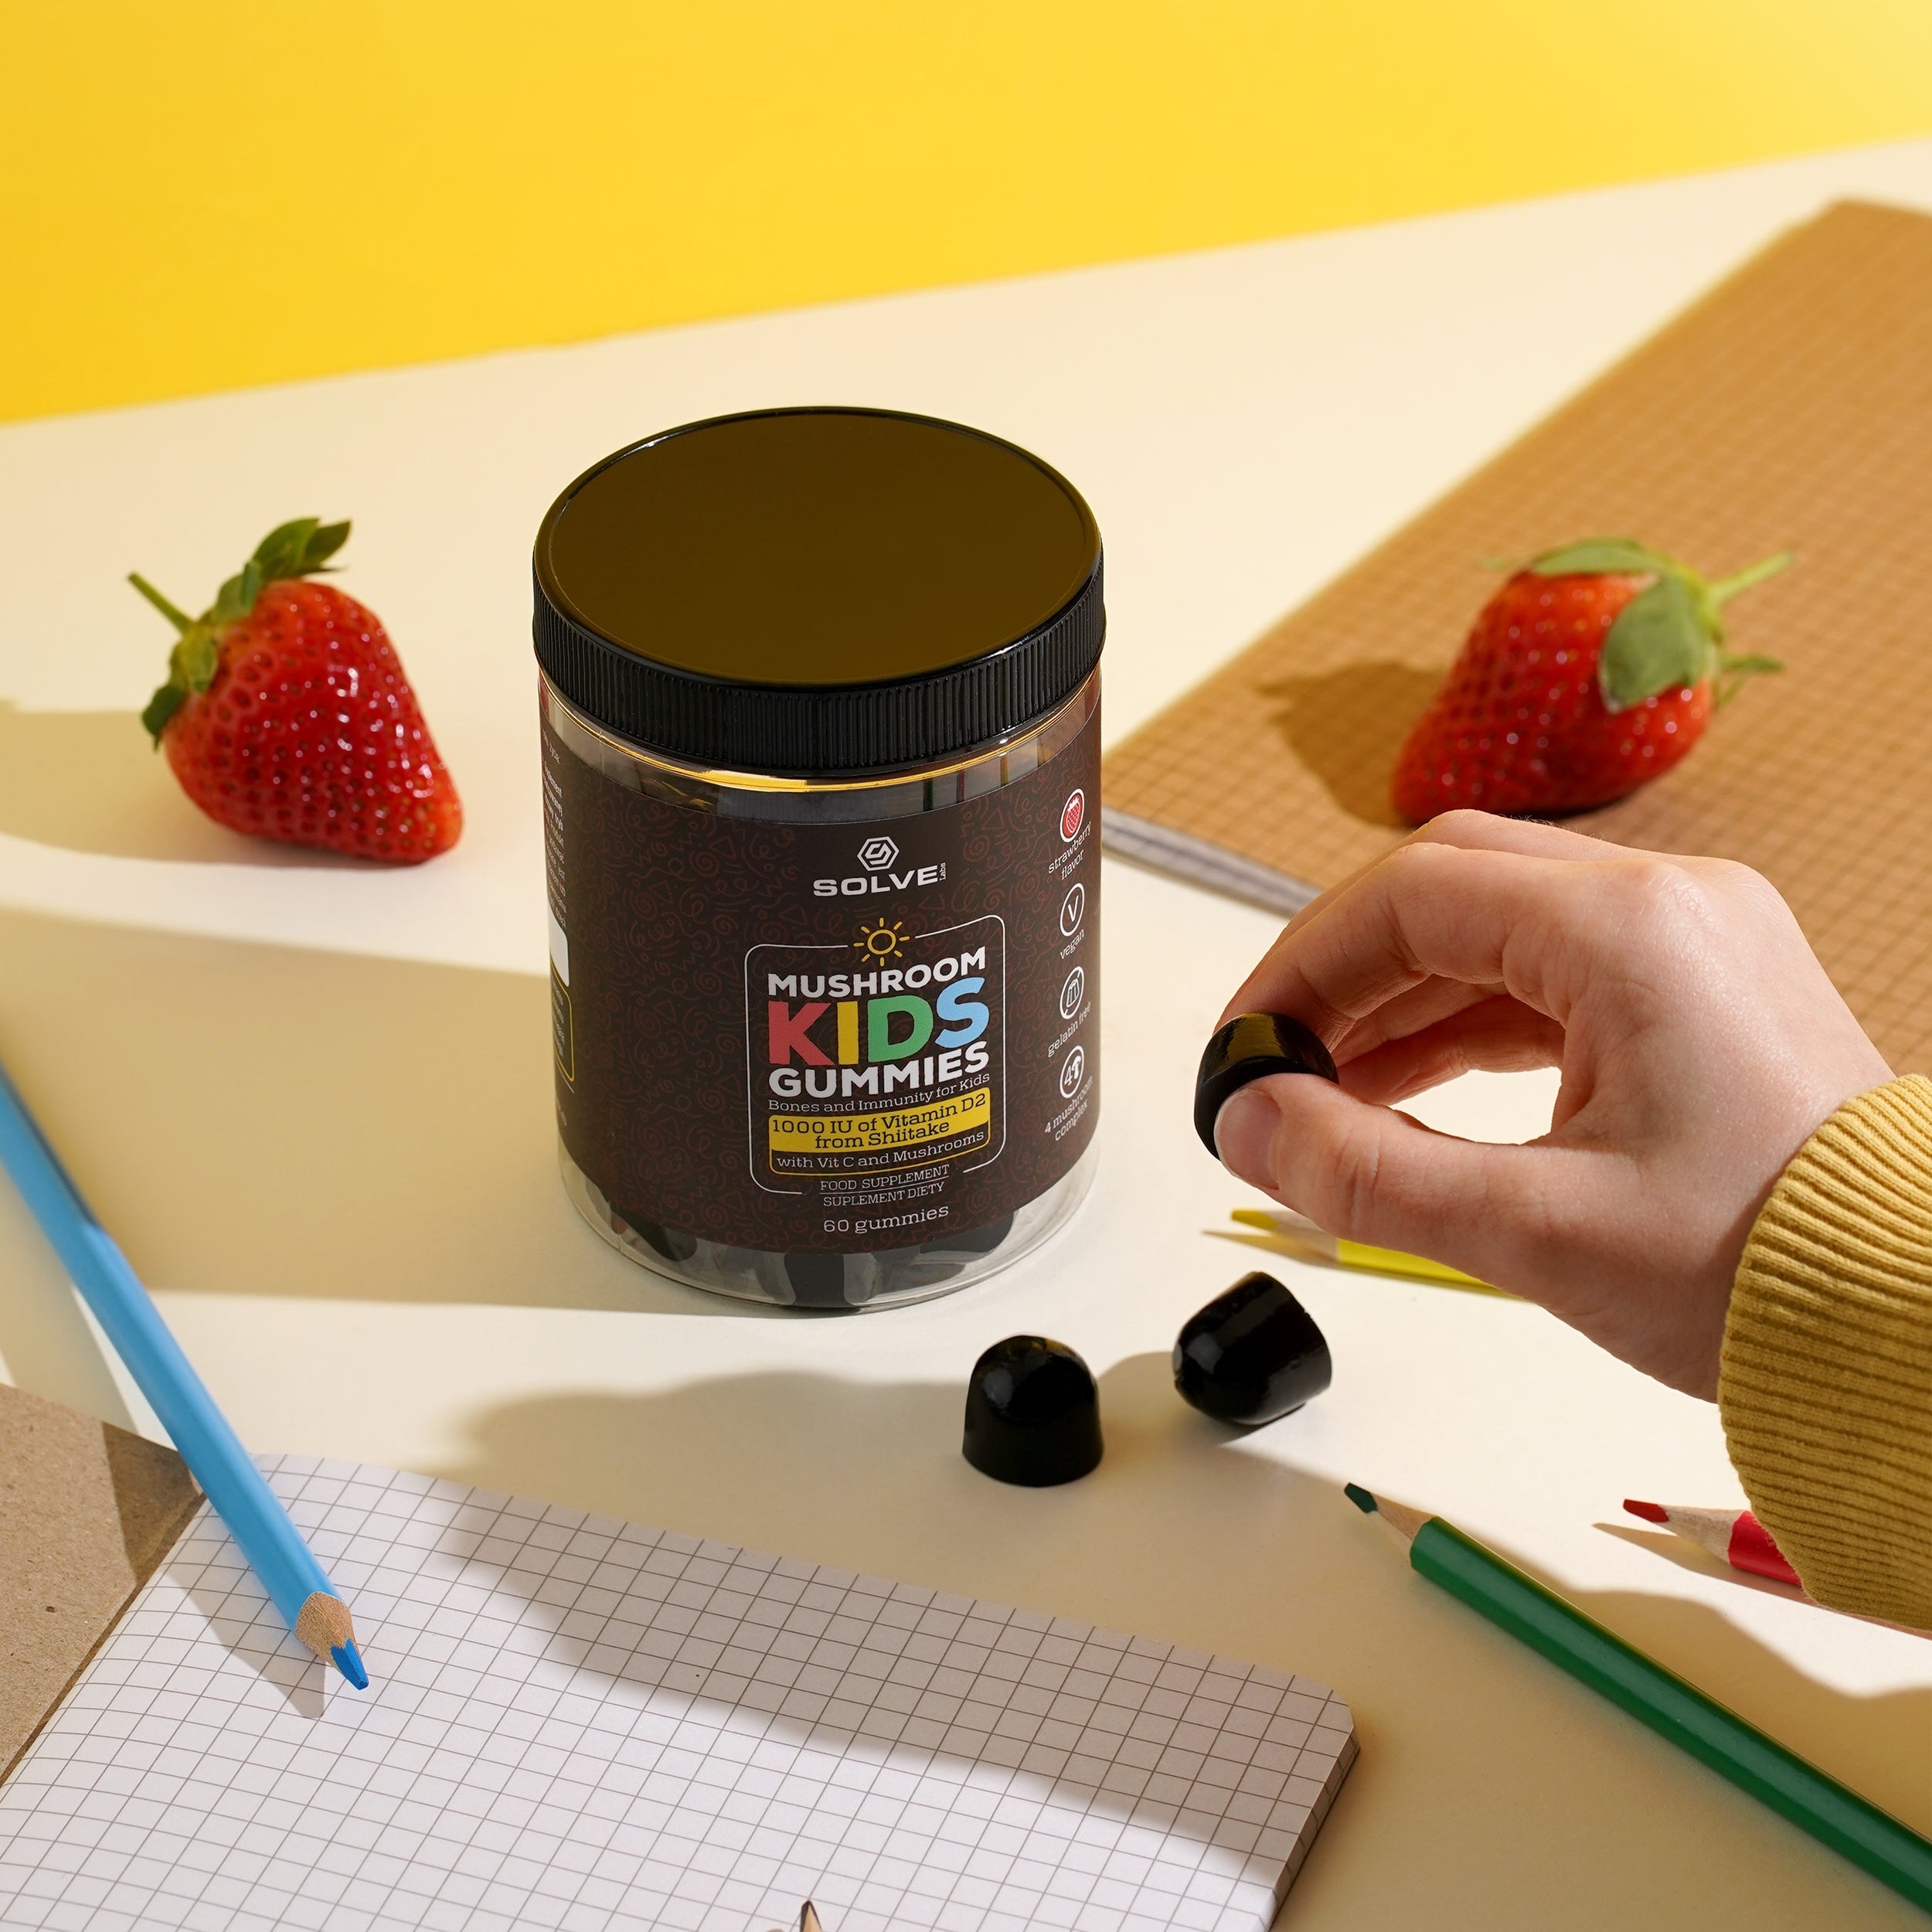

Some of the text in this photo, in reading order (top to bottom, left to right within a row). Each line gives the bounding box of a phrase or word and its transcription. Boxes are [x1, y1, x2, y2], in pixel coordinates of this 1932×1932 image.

[1048, 821, 1091, 874] strawberry
[1061, 849, 1084, 881] flavor
[813, 865, 938, 896] SOLVE
[1060, 928, 1084, 960] vegan
[767, 946, 986, 998] MUSHROOM
[767, 977, 990, 1066] KIDS
[1048, 1002, 1091, 1058] gelatin free
[768, 1041, 990, 1098] GUMMIES
[768, 1073, 990, 1113] Bones and Immunity for Kids
[773, 1093, 986, 1134] 1000 IU of Vitamin D2
[1044, 1121, 1052, 1134] 4
[1055, 1099, 1088, 1141] complex
[777, 1131, 985, 1169] with Vit C and Mushrooms
[815, 1122, 950, 1149] from Shiitake
[820, 1164, 950, 1192] FOOD SUPPLEMENT
[823, 1182, 945, 1207] SUPLEMENT DIETY
[823, 1206, 950, 1234] 60 gummies
